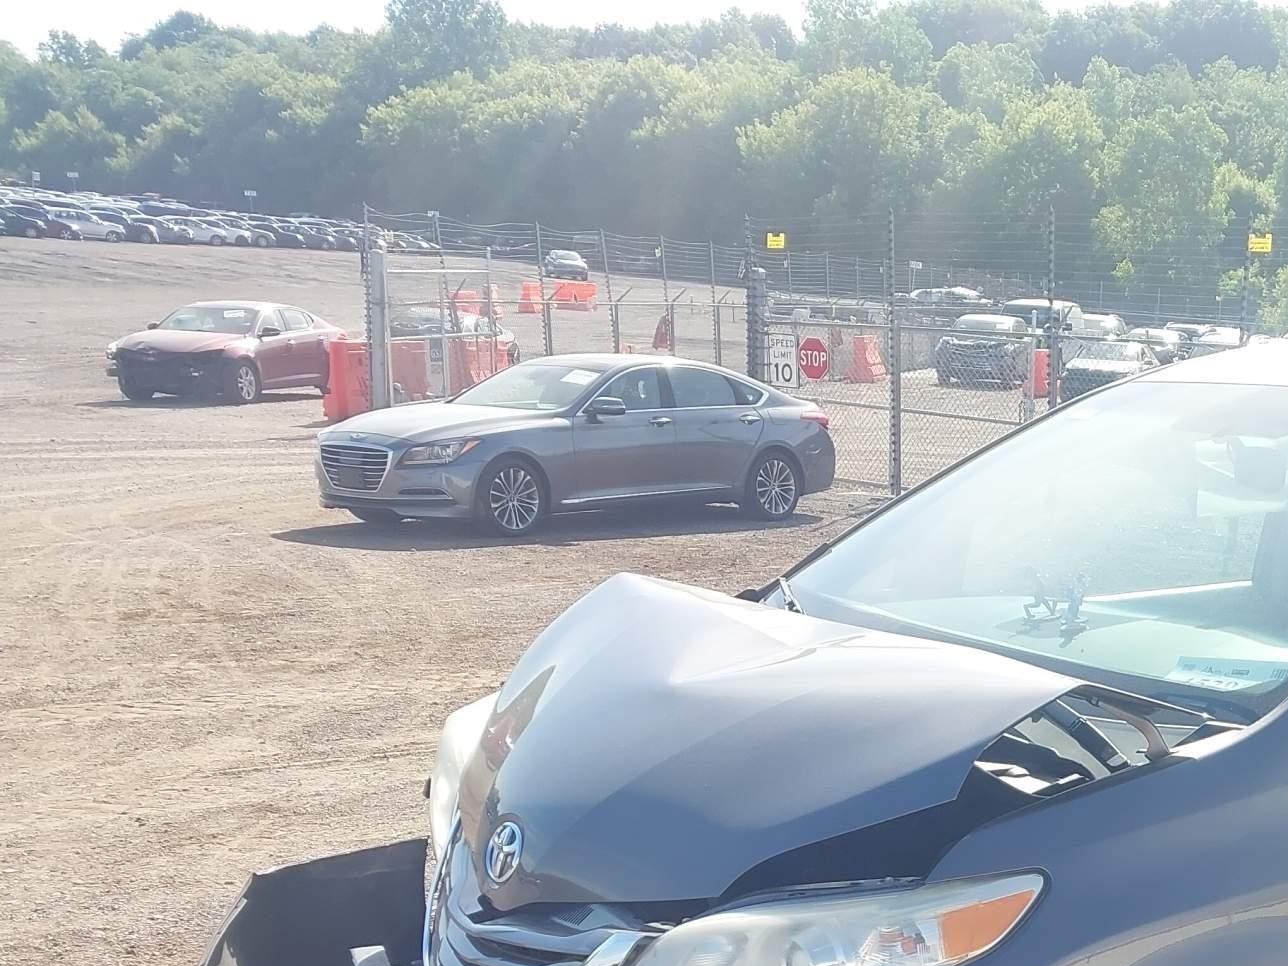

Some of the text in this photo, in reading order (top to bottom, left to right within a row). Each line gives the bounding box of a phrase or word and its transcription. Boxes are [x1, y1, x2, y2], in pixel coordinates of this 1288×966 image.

[770, 338, 794, 348] SPEED
[773, 350, 792, 360] LIMIT
[800, 349, 827, 367] STOP
[774, 362, 793, 382] 10
